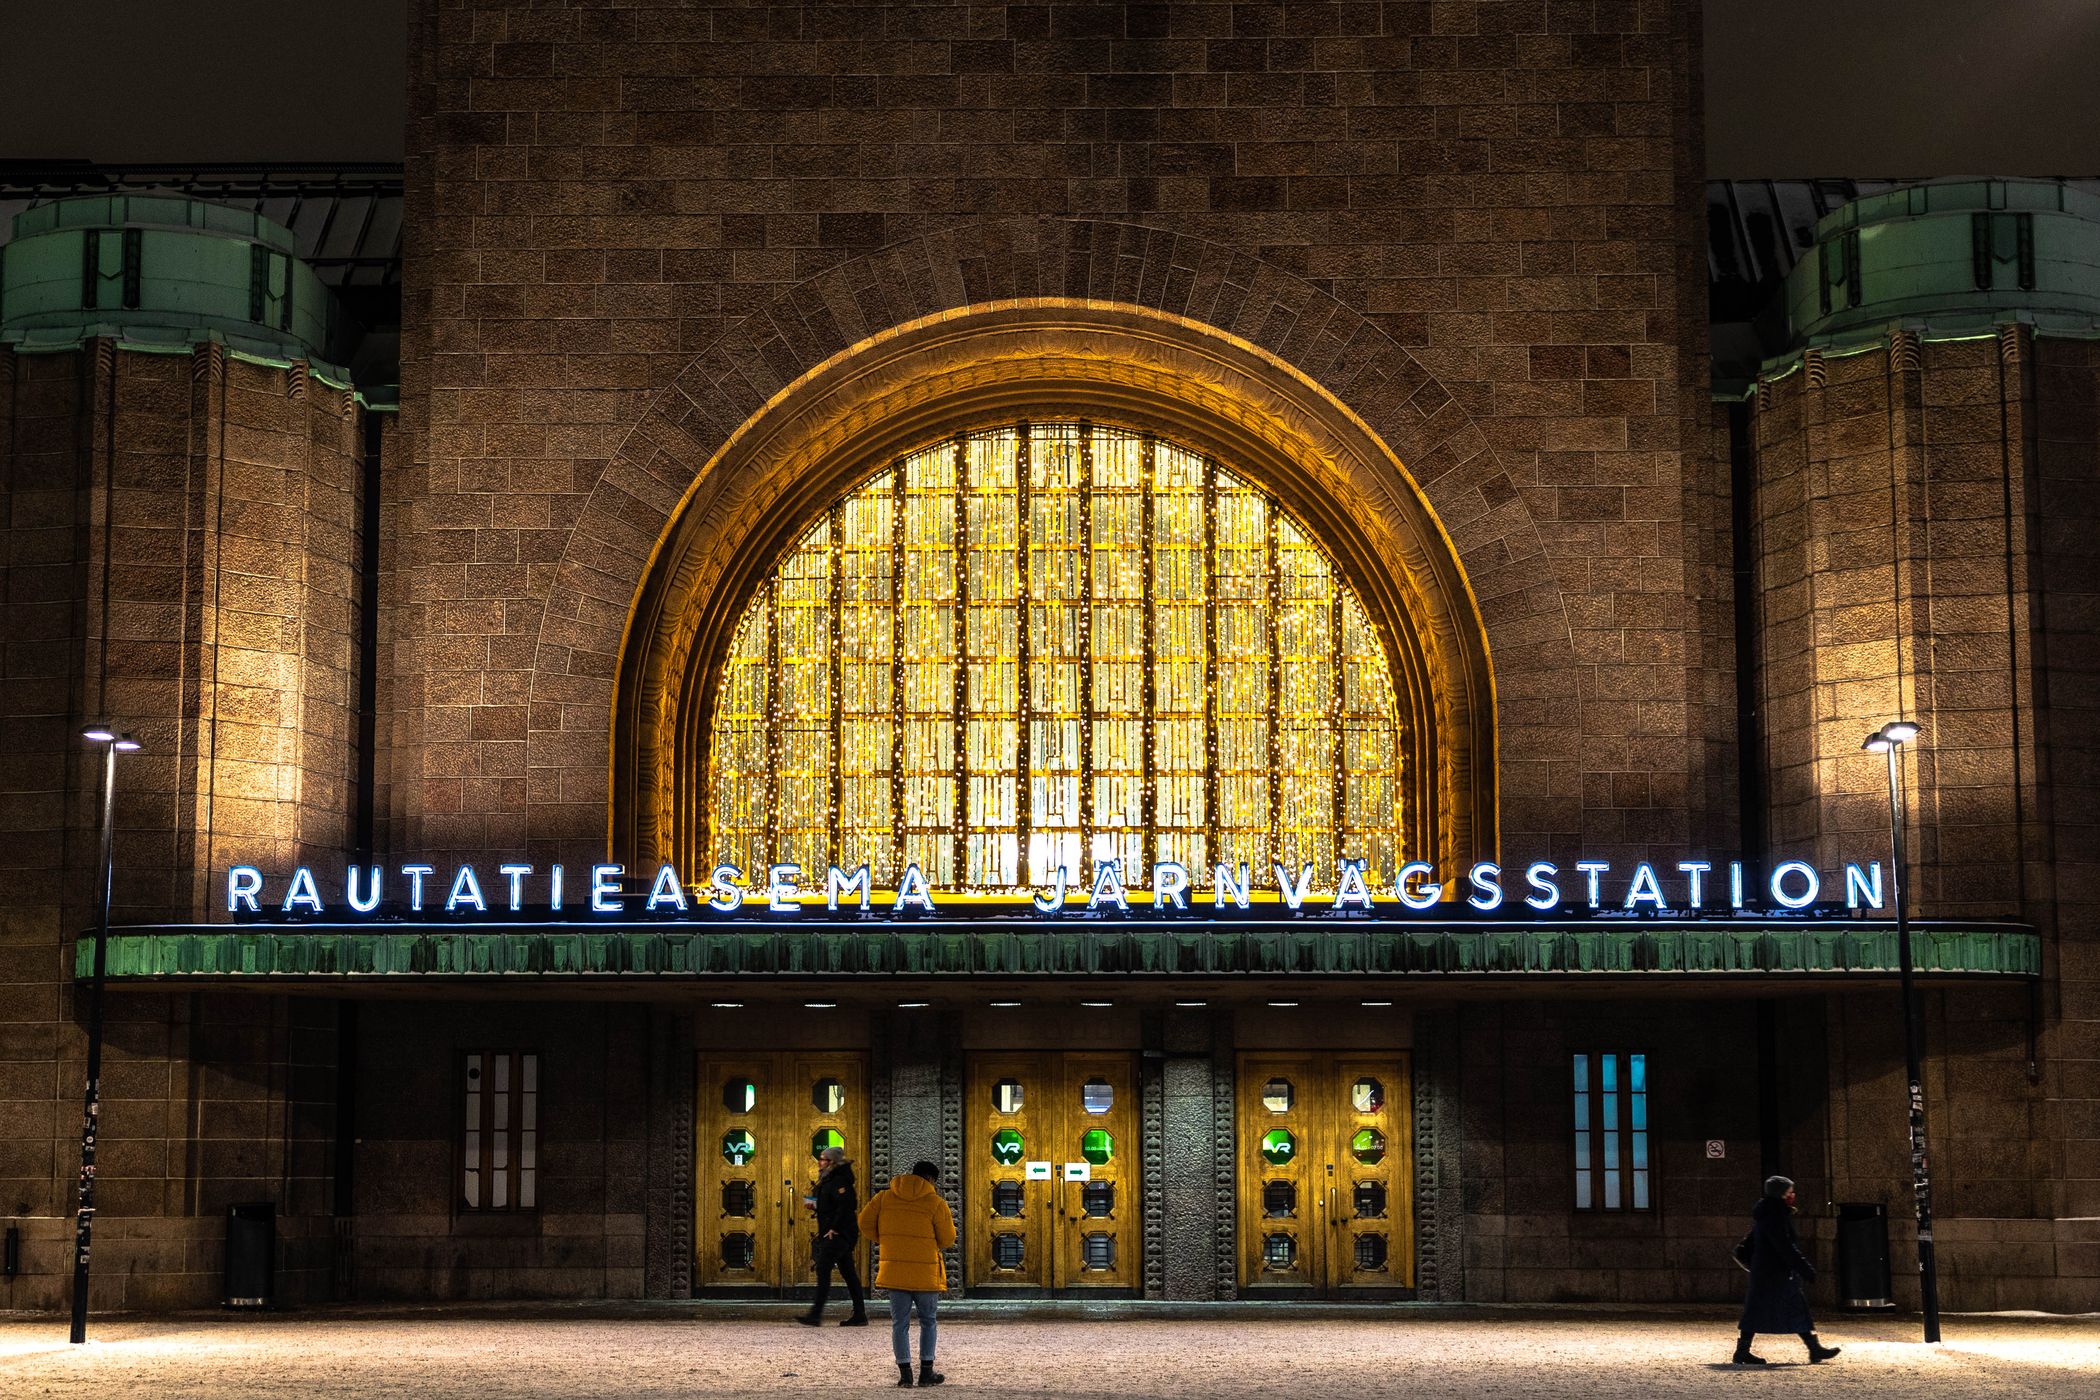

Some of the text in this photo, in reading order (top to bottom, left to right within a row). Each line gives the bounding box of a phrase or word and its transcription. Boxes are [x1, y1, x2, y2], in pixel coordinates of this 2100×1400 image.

[227, 858, 1885, 912] RAUTATIEASEMA JÄRNVÄGSSTATION
[726, 1142, 750, 1154] VR
[995, 1142, 1020, 1154] VR
[1266, 1142, 1291, 1154] VR
